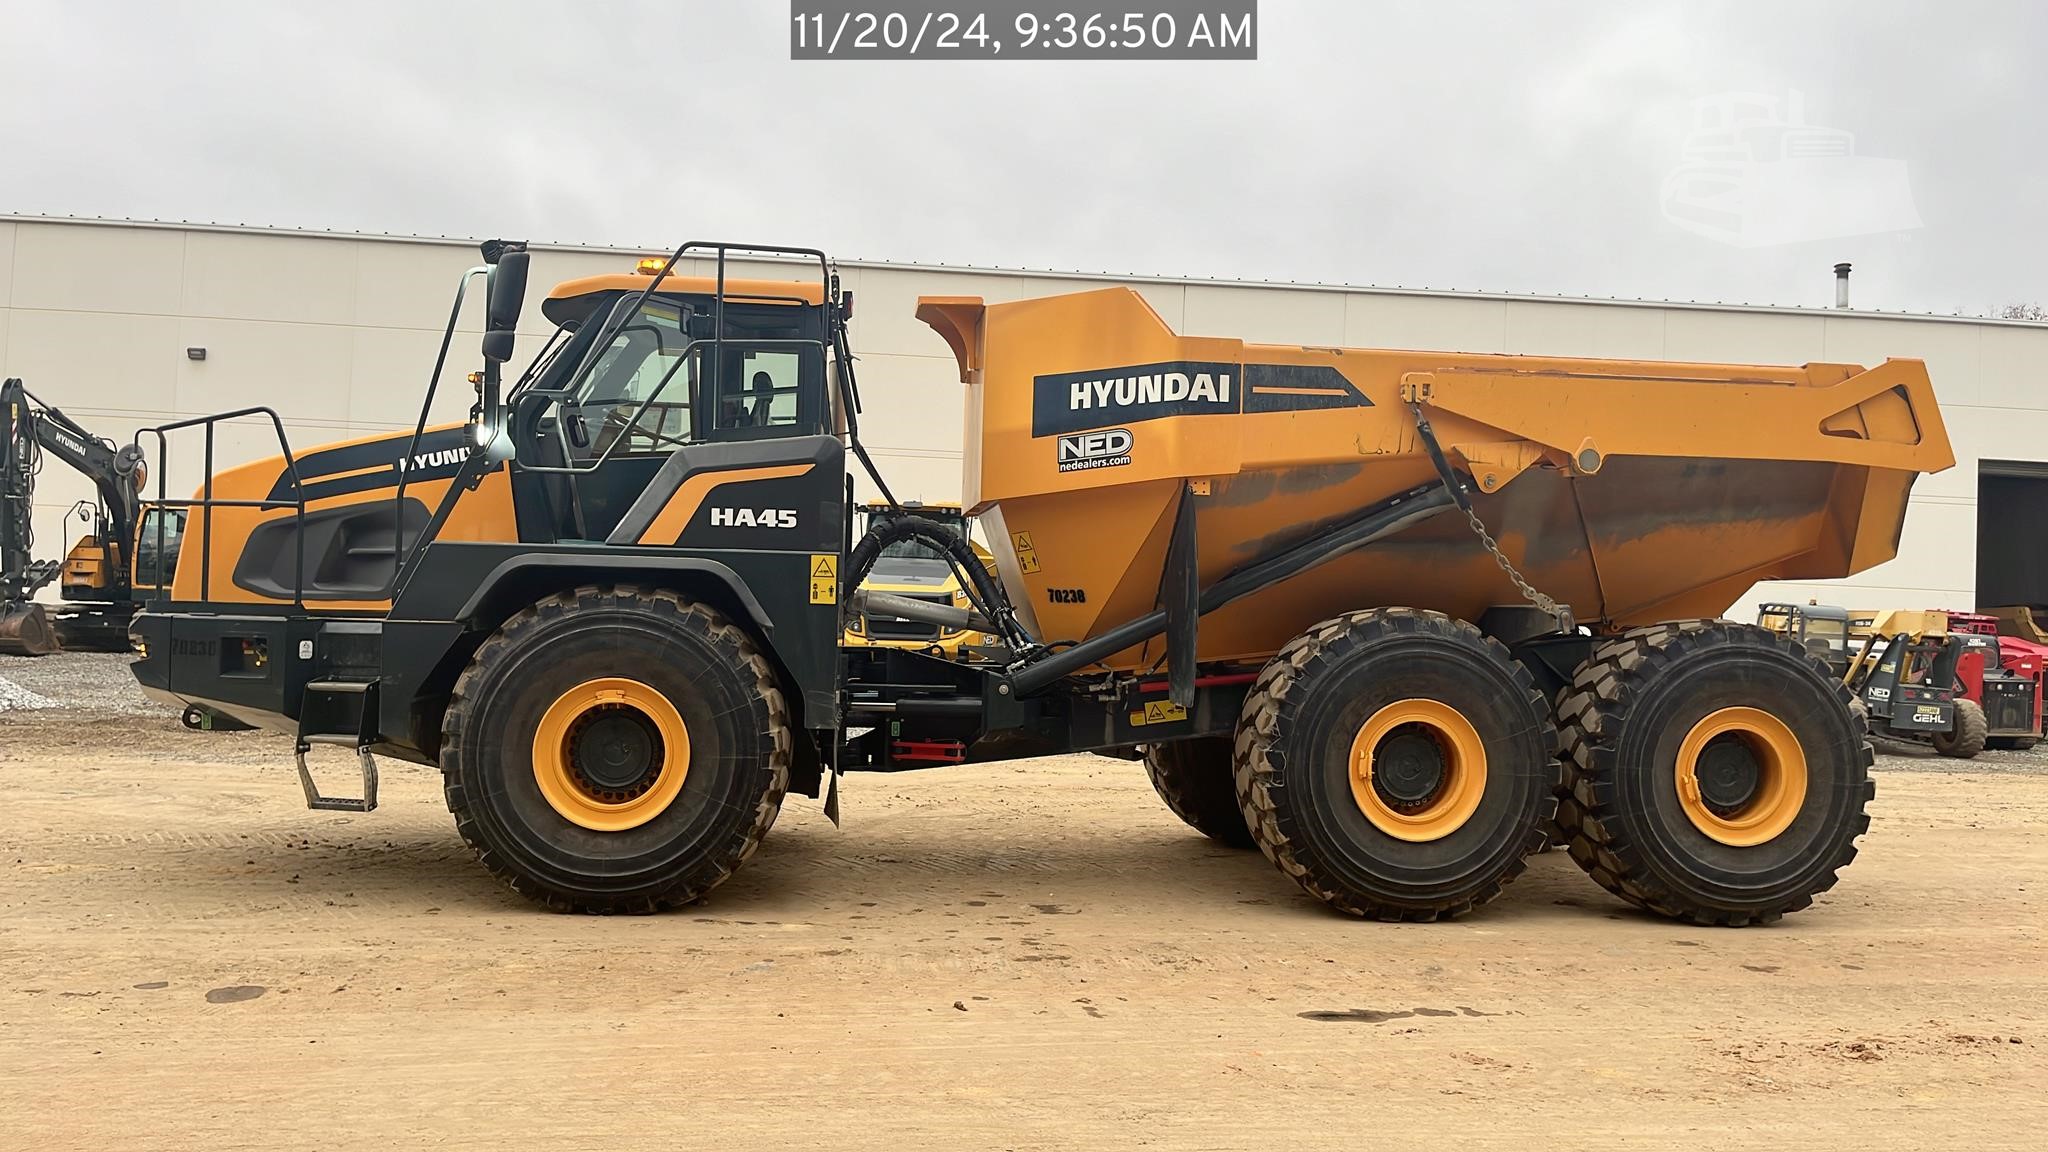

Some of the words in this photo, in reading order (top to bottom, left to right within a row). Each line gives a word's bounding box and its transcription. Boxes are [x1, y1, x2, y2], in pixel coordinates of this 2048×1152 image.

[1070, 373, 1231, 410] HYUNDAI
[55, 431, 87, 457] HYUNDAI
[1059, 432, 1132, 460] NED
[1059, 455, 1131, 472] nedealers.com
[710, 507, 798, 528] HA45
[1868, 687, 1891, 698] NED
[1912, 713, 1946, 724] GEHL
